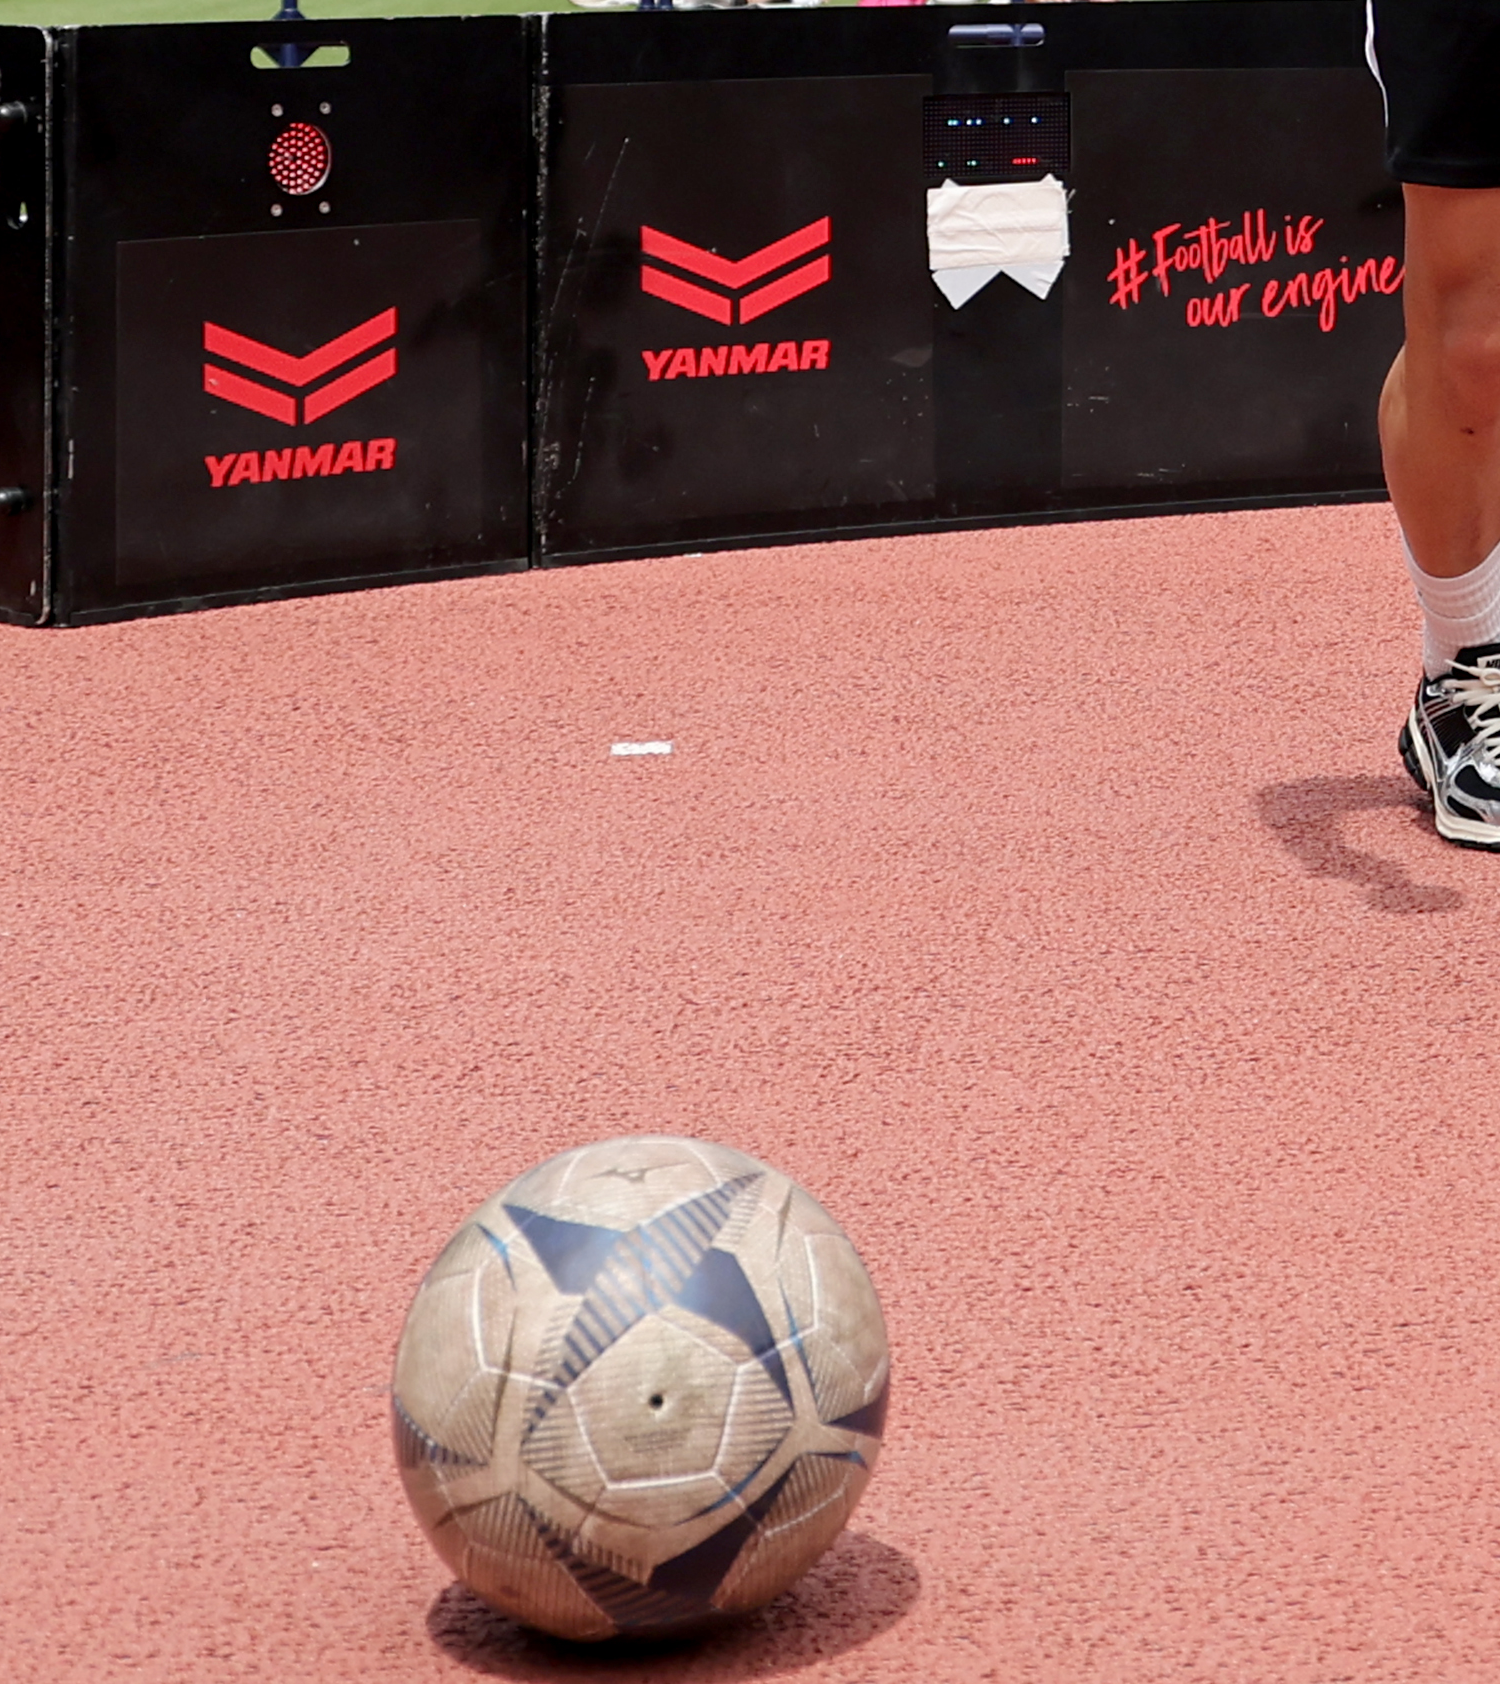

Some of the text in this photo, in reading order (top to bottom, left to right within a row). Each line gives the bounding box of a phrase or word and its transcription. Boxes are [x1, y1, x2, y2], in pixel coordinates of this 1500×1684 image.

[1107, 209, 1325, 309] #Football is
[1186, 255, 1406, 333] our engine
[641, 338, 831, 382] YANMAR
[203, 436, 397, 489] YANMAR
